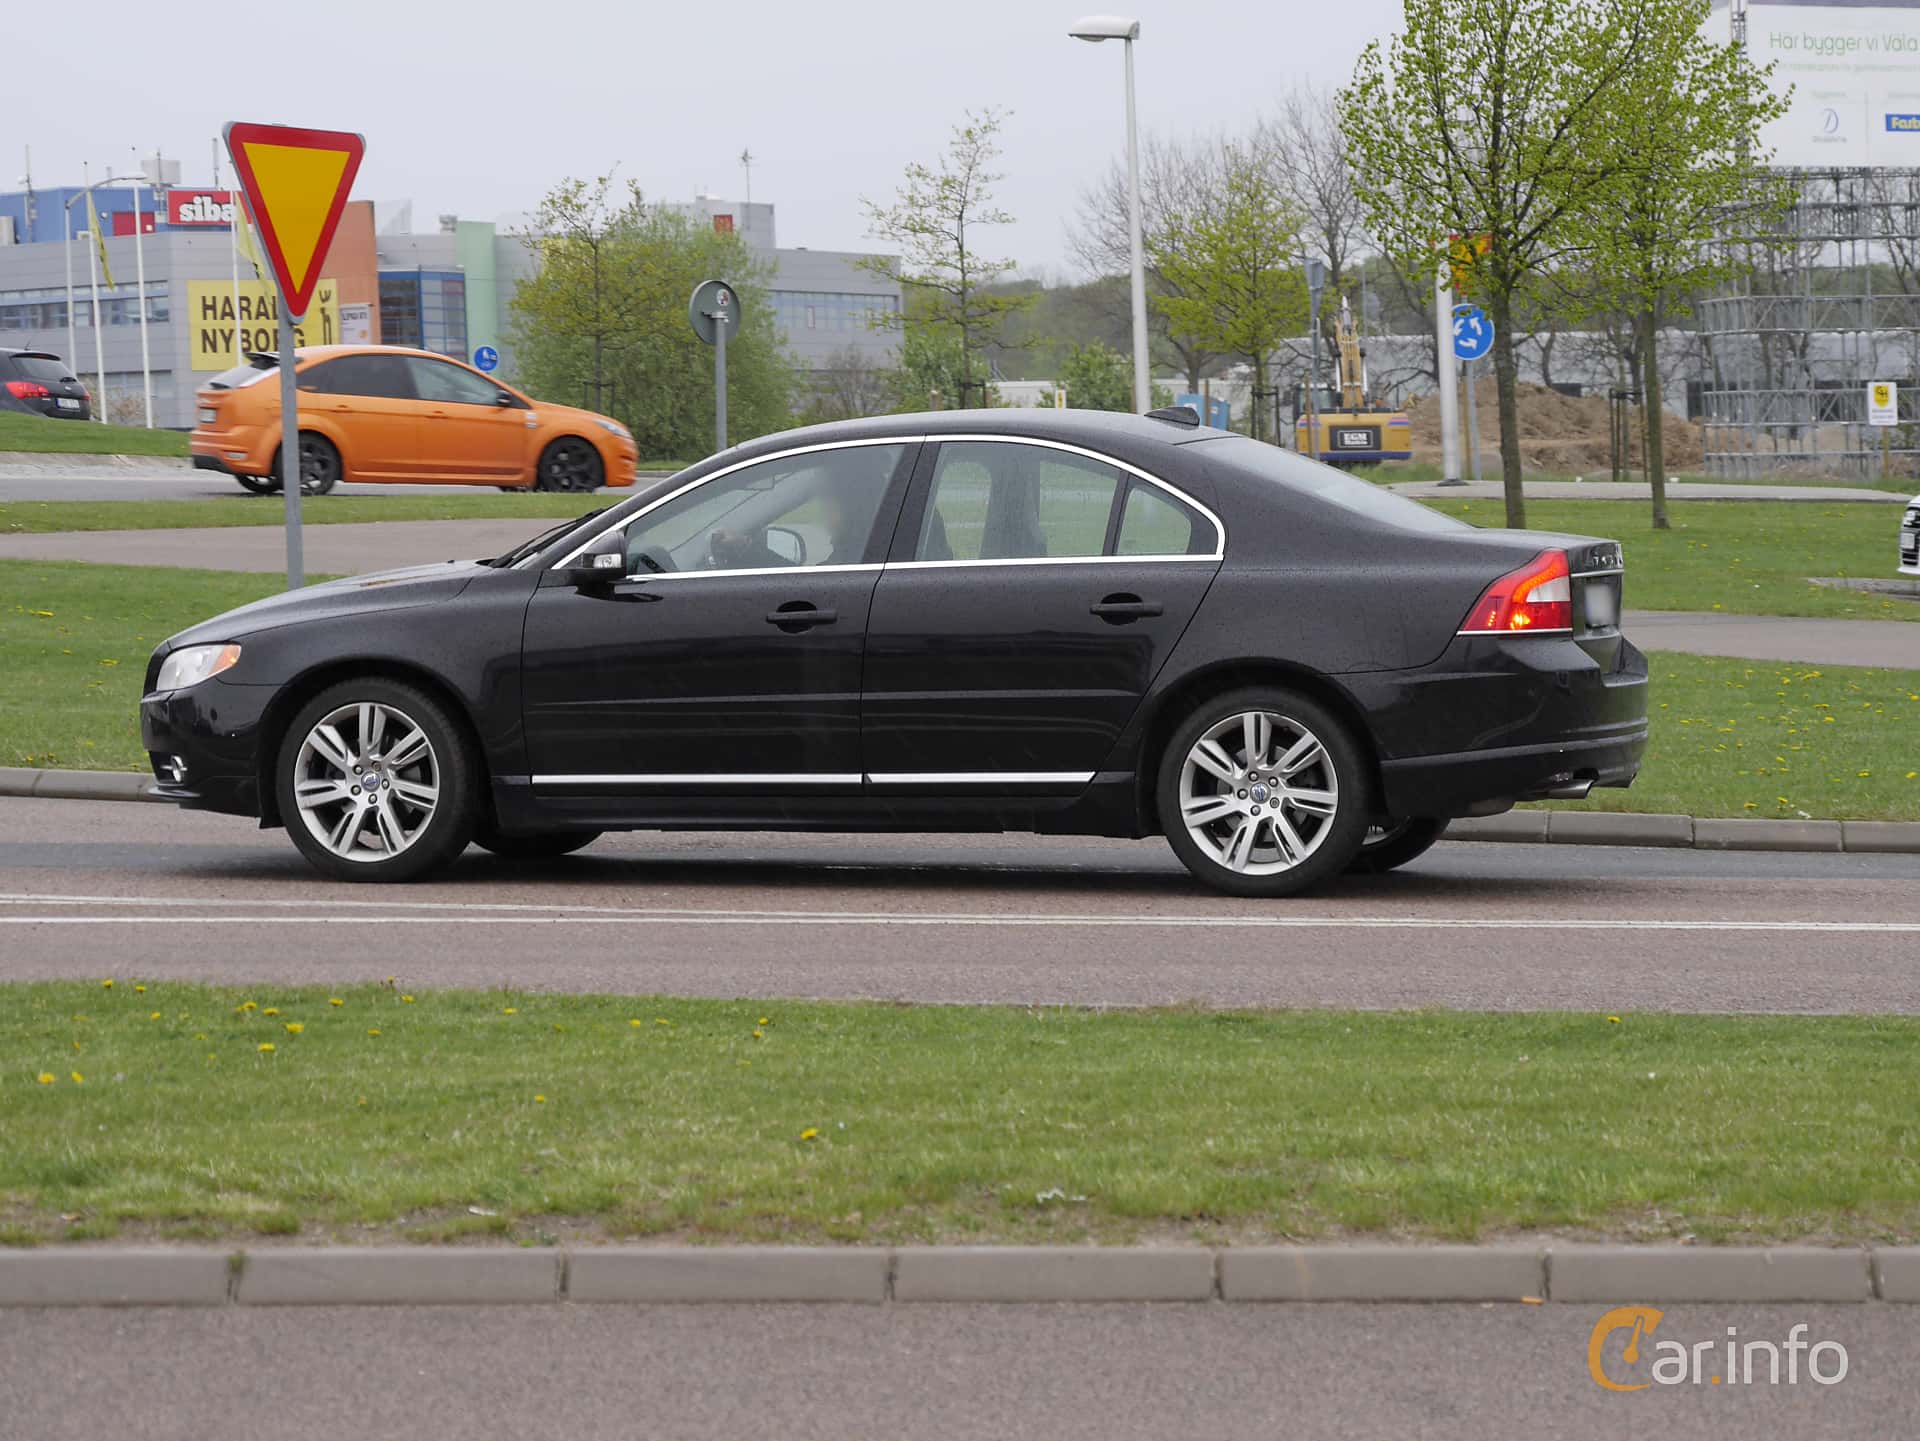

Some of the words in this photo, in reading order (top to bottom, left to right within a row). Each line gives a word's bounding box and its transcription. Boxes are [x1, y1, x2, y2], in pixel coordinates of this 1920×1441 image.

[1803, 32, 1862, 56] bygger
[1865, 34, 1879, 50] vi
[179, 195, 238, 222] siba
[201, 295, 278, 321] HARAL
